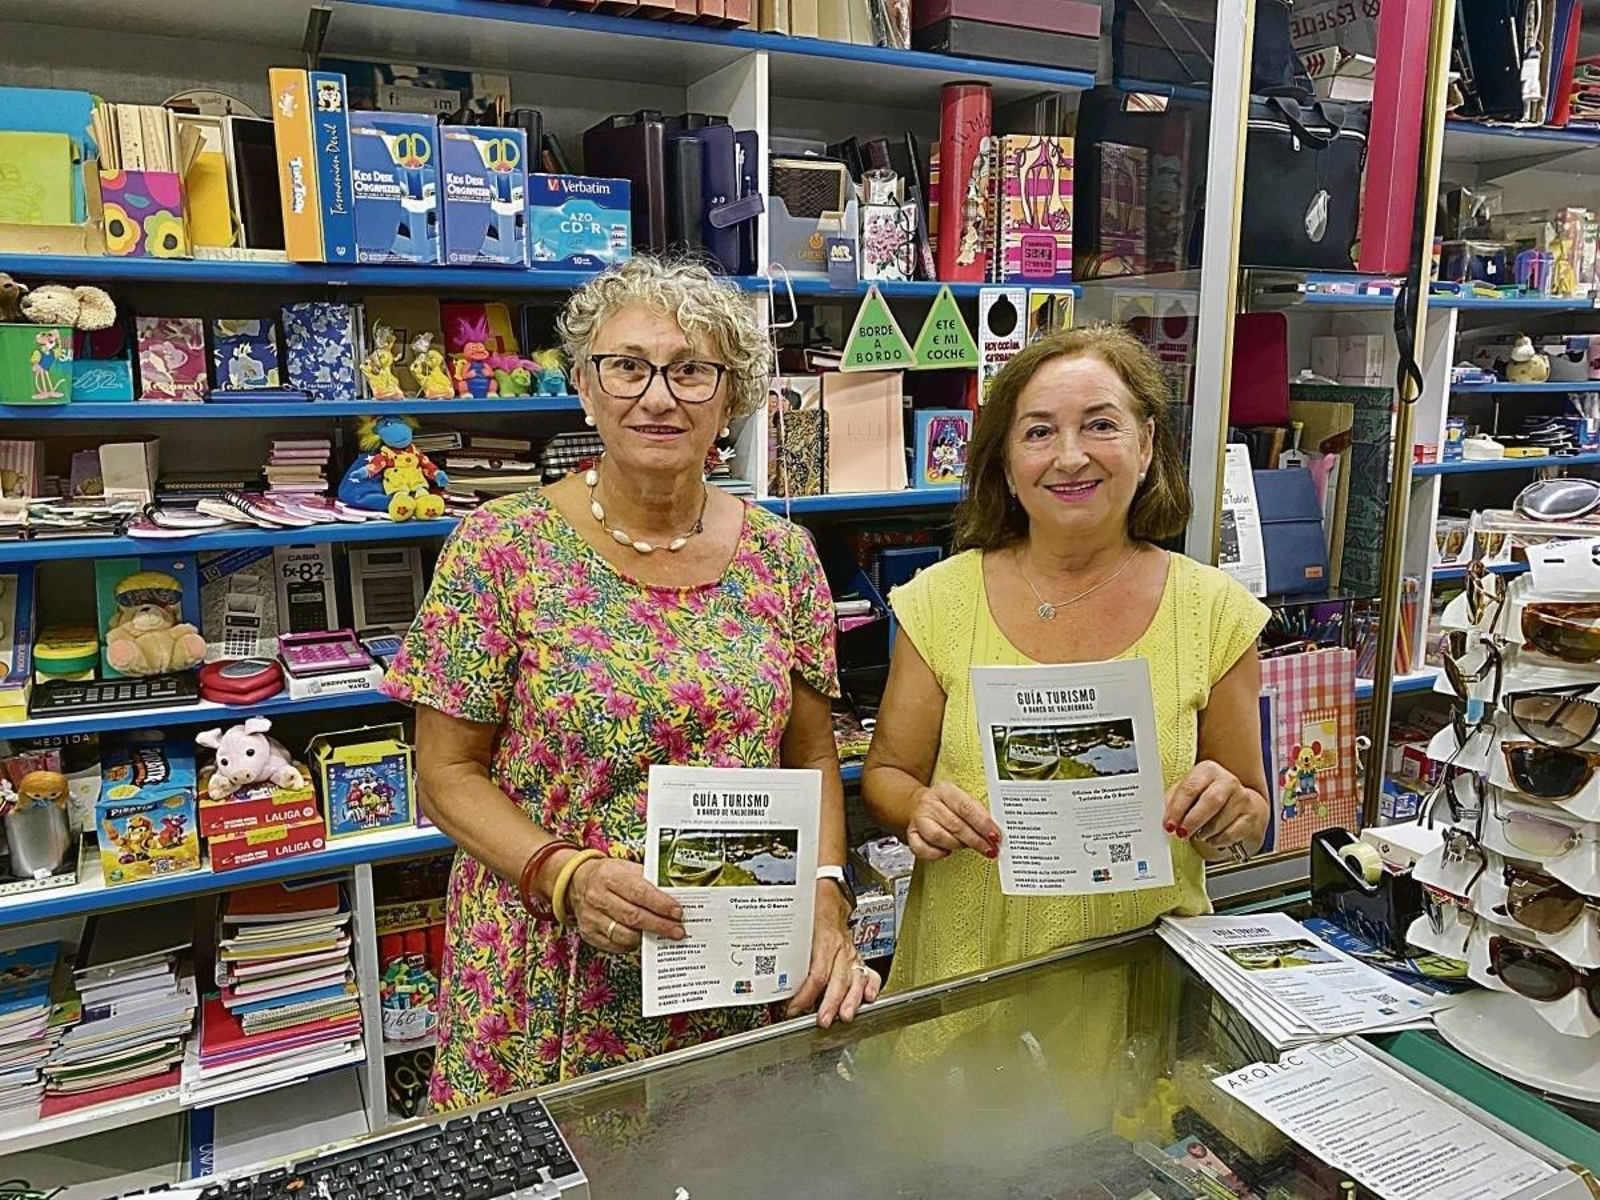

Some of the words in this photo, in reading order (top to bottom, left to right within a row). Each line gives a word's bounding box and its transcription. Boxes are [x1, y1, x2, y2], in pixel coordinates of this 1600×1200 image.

[561, 180, 611, 194] Verbatim
[570, 213, 593, 222] AZO
[560, 221, 601, 234] CD-R
[859, 324, 894, 338] BORDE
[936, 320, 955, 330] ETE
[874, 339, 883, 349] A
[944, 334, 958, 345] MI
[856, 350, 902, 363] BORDO
[927, 349, 965, 360] COCHE
[282, 562, 325, 581] fx-82
[1017, 689, 1043, 705] GUÍA
[1045, 688, 1096, 704] TURISMO
[33, 733, 91, 747] MEDIDA
[693, 791, 717, 807] GUÍA
[722, 793, 769, 808] TURISMO
[265, 810, 301, 823] LALIGA
[275, 842, 311, 856] LALIGA
[383, 1012, 417, 1028] 0,60
